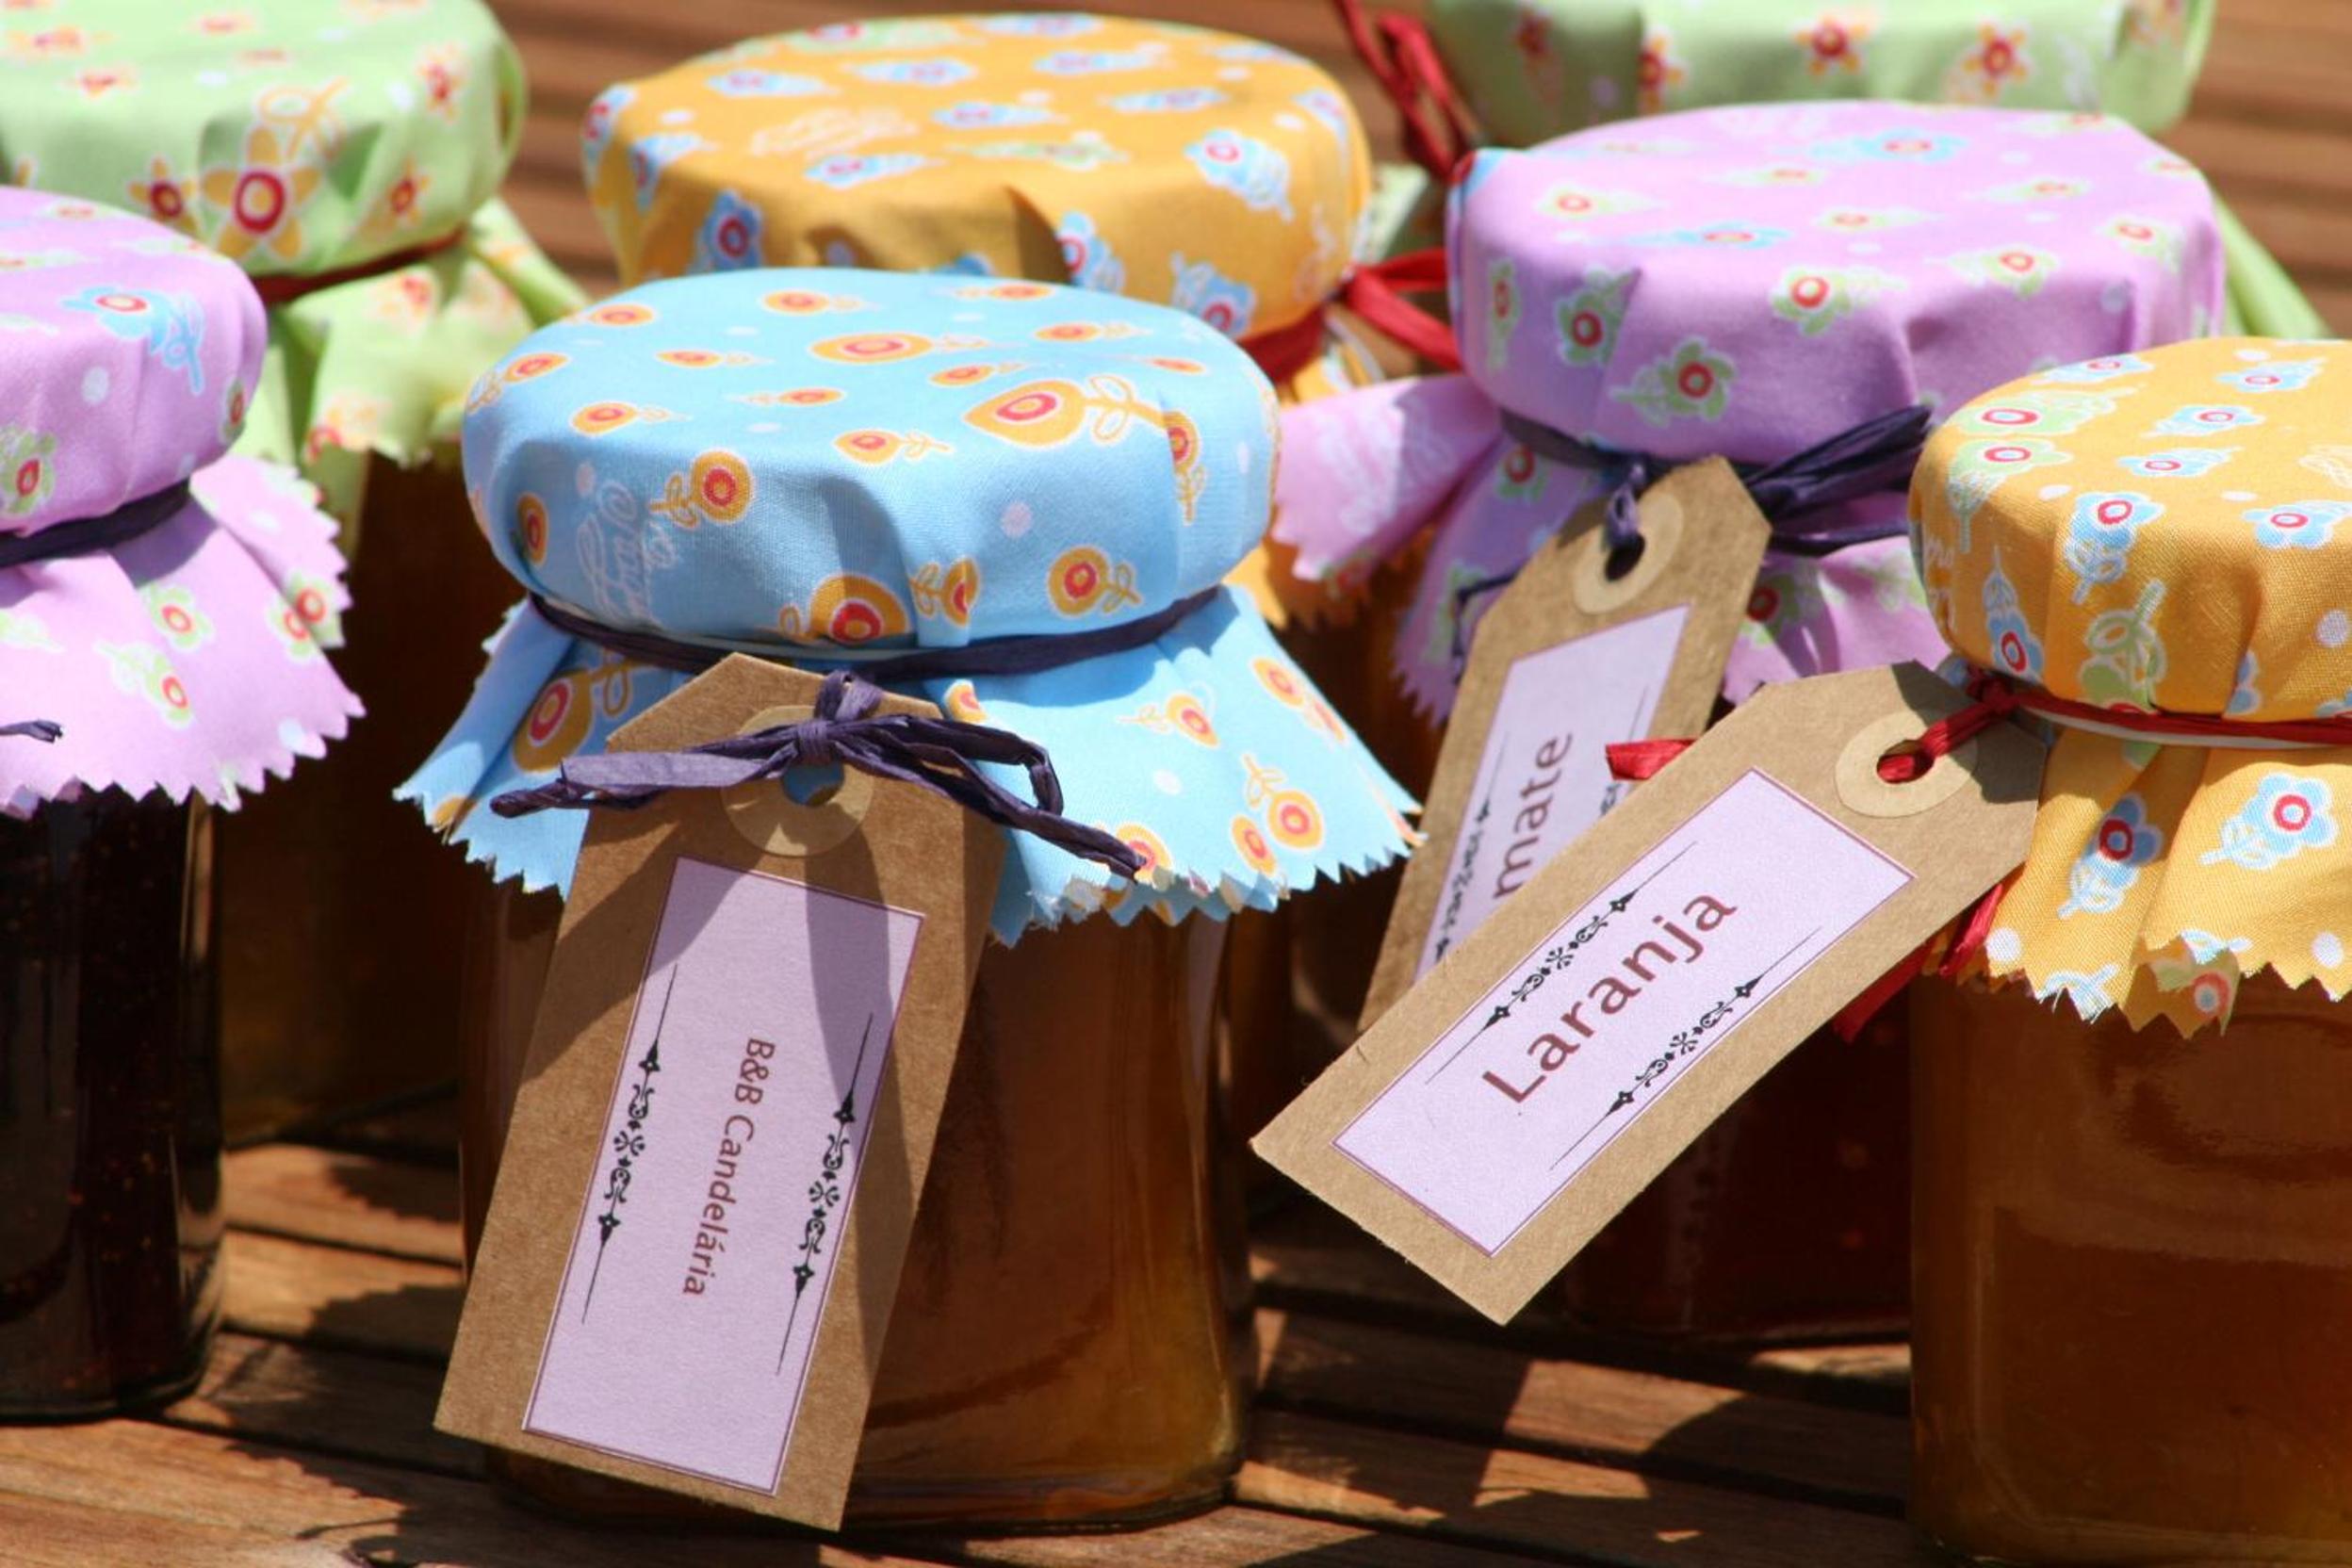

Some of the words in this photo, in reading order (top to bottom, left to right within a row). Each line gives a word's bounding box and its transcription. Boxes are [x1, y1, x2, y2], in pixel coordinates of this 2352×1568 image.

[1492, 732, 1574, 900] mate
[734, 1037, 776, 1105] B&B
[1482, 893, 1737, 1104] Laranja
[682, 1114, 755, 1296] Candelária
